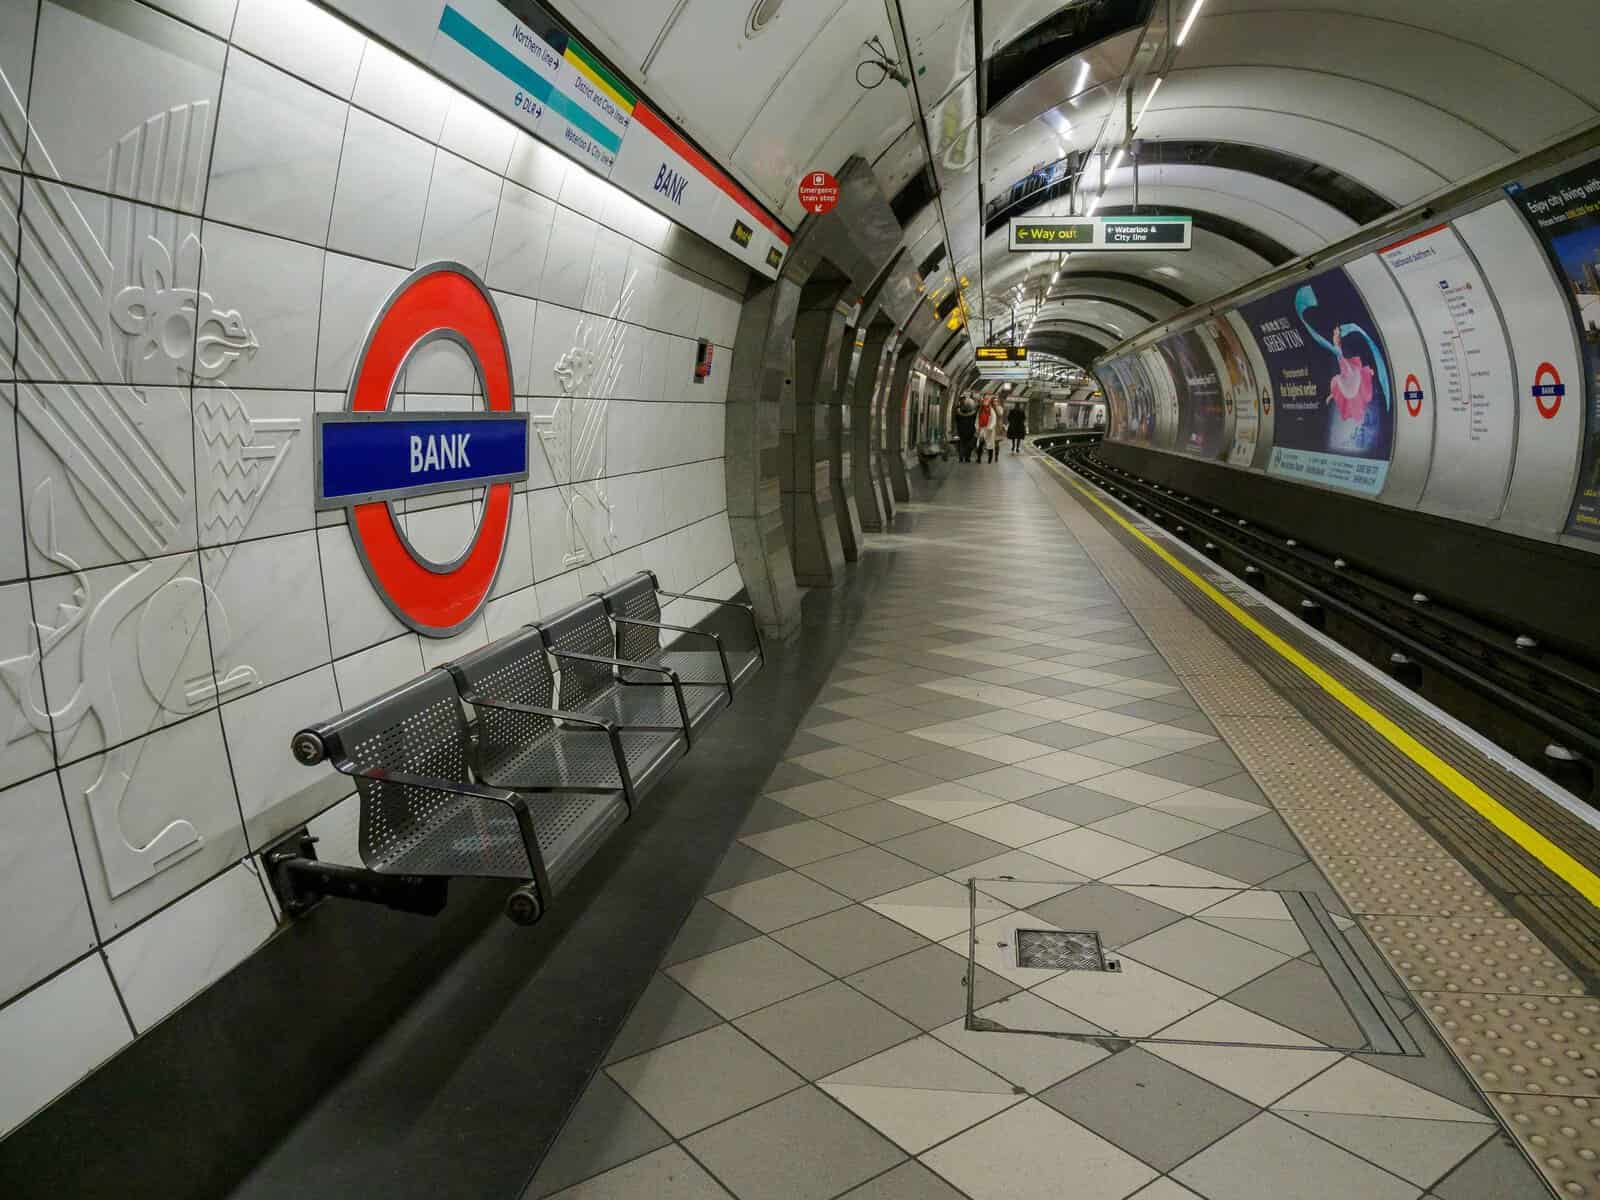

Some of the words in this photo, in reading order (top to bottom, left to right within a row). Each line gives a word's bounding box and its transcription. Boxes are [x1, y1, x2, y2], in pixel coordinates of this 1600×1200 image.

[512, 23, 542, 60] Northern
[541, 47, 554, 67] line
[575, 76, 594, 100] District
[522, 97, 537, 117] DLR
[565, 127, 587, 149] Waterloo
[653, 162, 689, 206] BANK
[800, 187, 837, 196] Emergency
[1560, 186, 1587, 202] living
[1031, 228, 1055, 241] Way
[1057, 228, 1077, 239] out
[1114, 226, 1148, 234] Waterloo
[1114, 234, 1131, 242] City
[1263, 333, 1287, 353] SHEN
[1284, 328, 1305, 350] YUN
[409, 432, 472, 473] BANK
